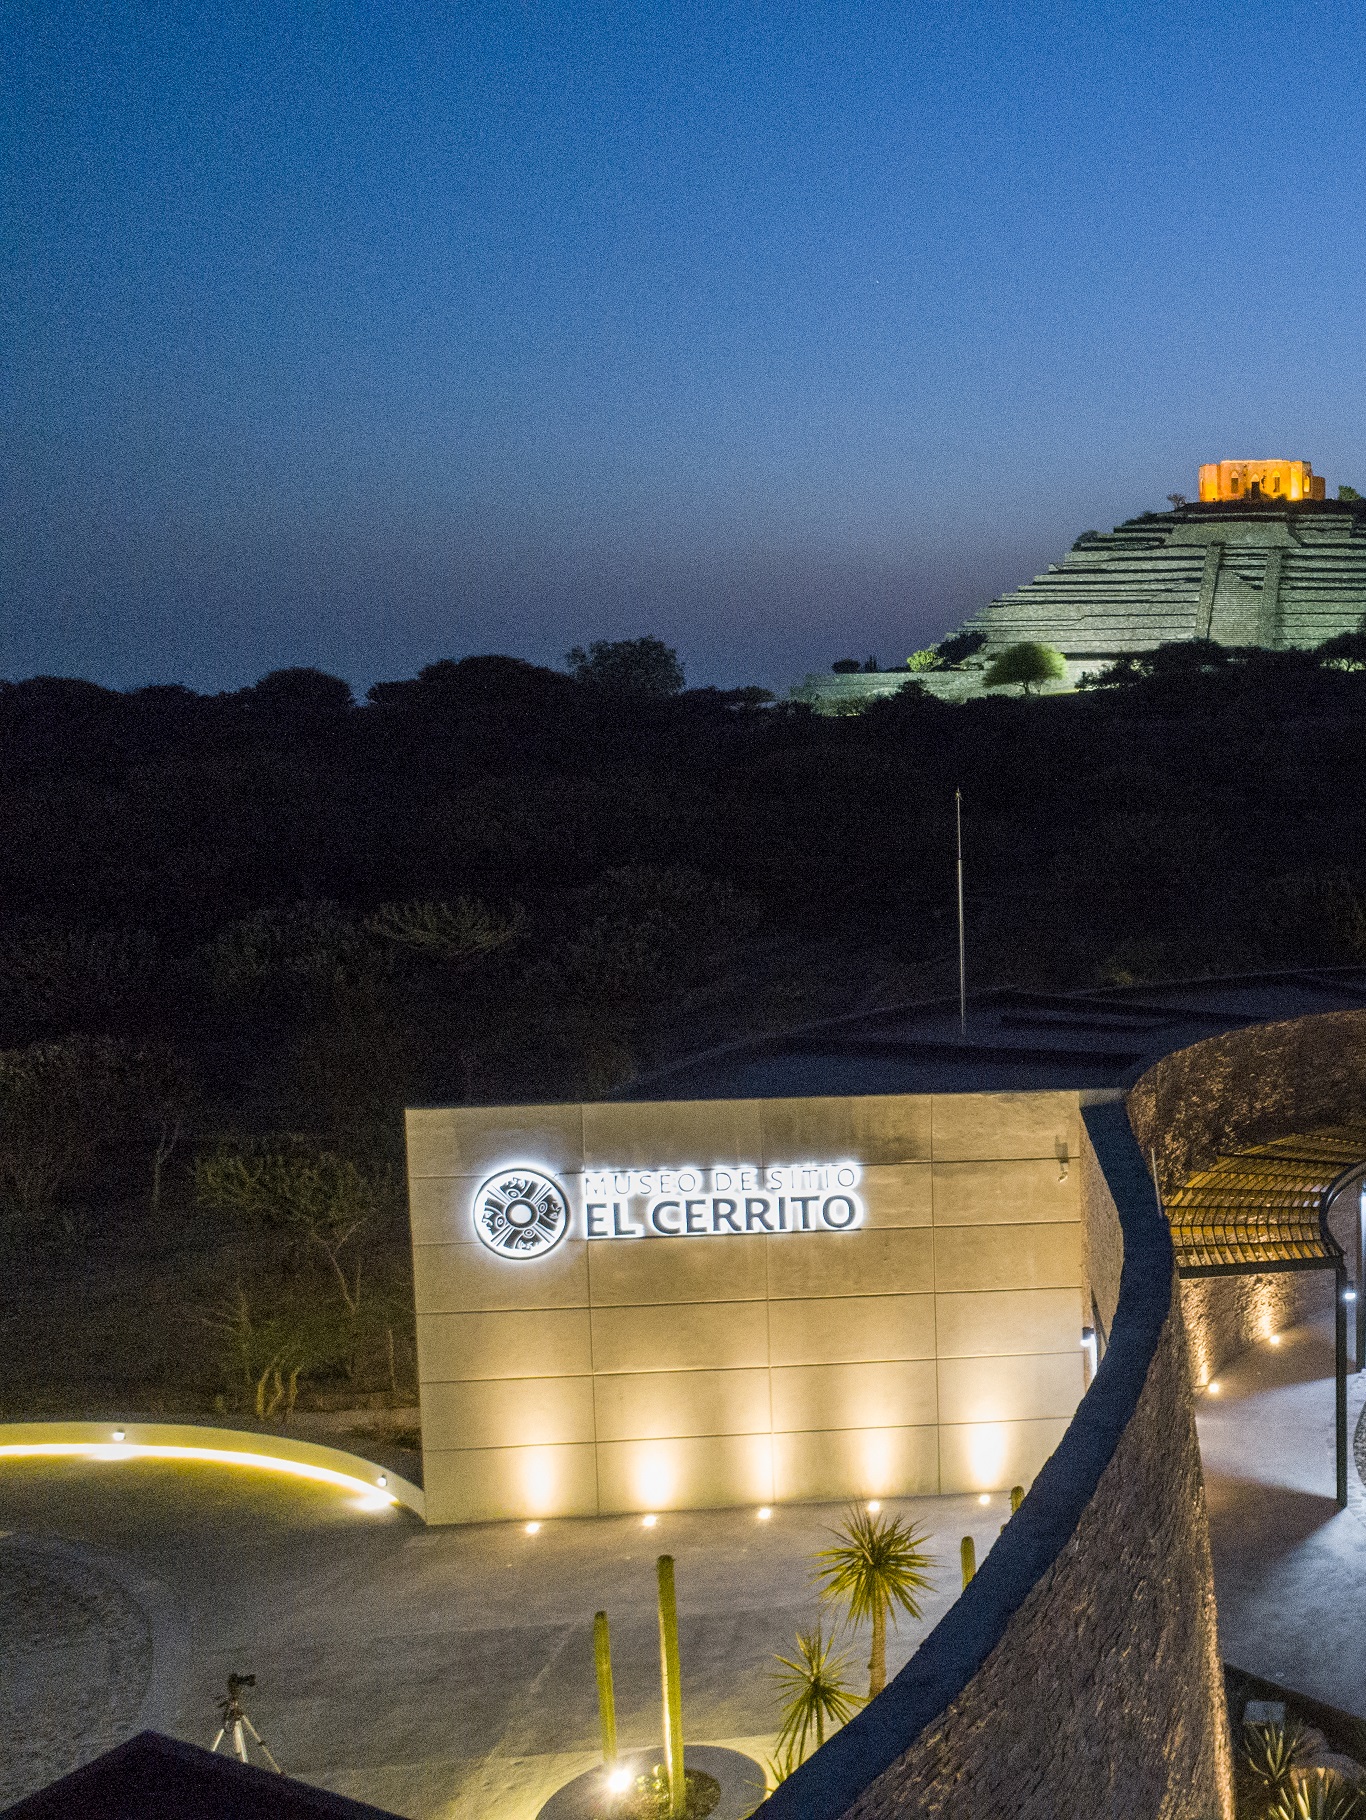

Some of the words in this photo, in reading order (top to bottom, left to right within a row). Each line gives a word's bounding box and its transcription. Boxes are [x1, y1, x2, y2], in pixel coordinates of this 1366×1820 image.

[585, 1173, 697, 1195] MUSEO
[715, 1170, 752, 1192] DE
[770, 1168, 855, 1190] SITIO
[586, 1202, 637, 1237] EL
[651, 1194, 857, 1235] CERRITO
